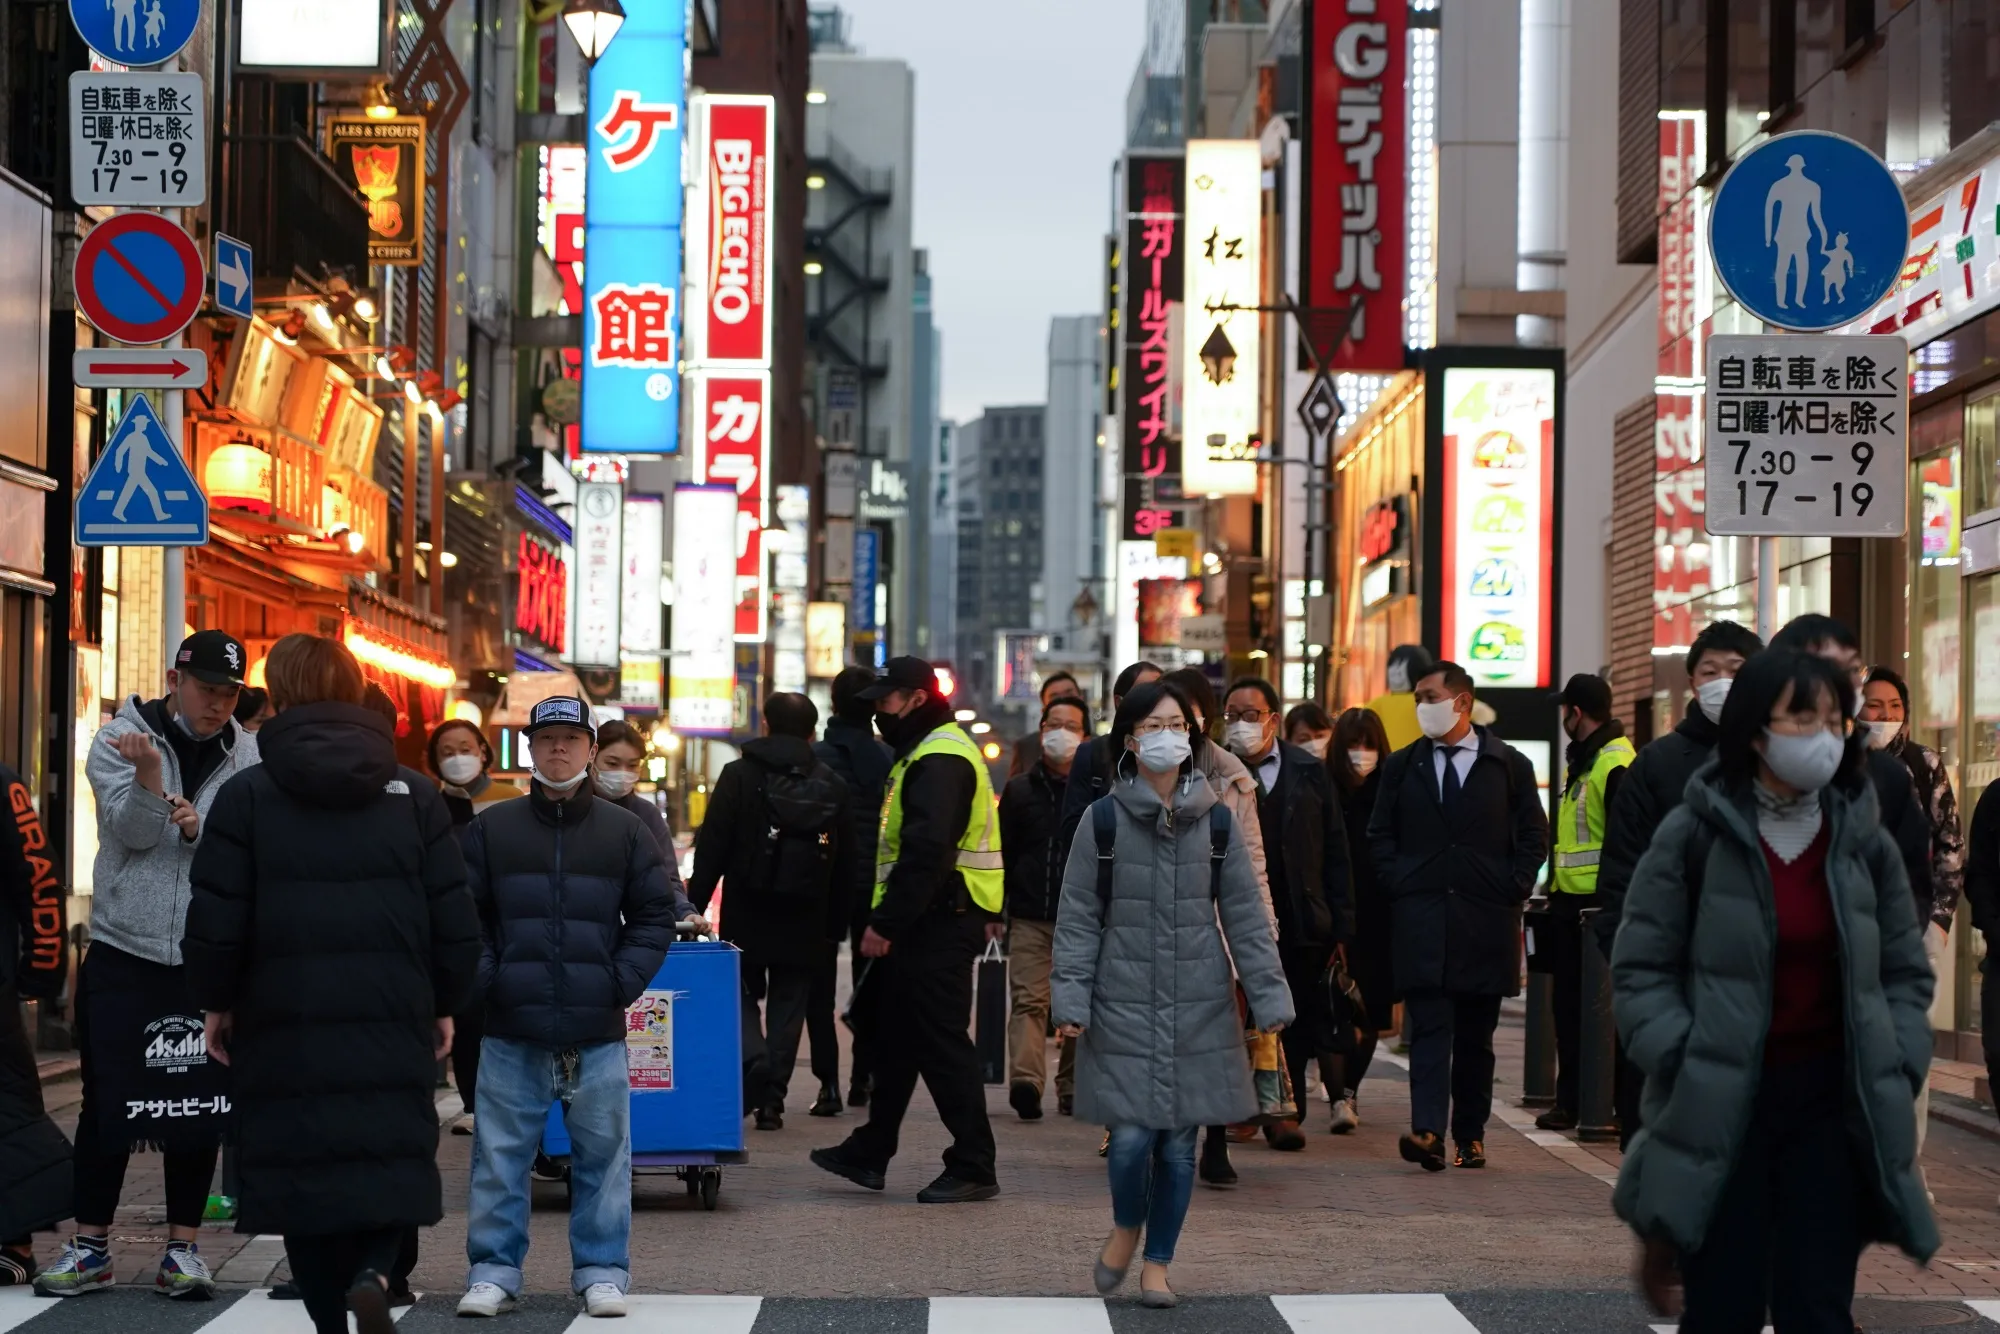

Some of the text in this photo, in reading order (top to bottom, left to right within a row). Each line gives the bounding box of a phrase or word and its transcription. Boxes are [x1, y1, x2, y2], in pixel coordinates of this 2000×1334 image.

[81, 86, 192, 112] 自転車を除く
[82, 116, 193, 140] 日曜・休日を除く
[334, 125, 361, 137] ALES
[374, 125, 419, 137] STOUTS
[91, 141, 132, 165] 7.30
[169, 142, 186, 166] 9
[92, 168, 120, 192] 17
[160, 169, 188, 194] 19
[1333, 0, 1389, 341] Gディッパー
[362, 200, 403, 238] UB
[713, 139, 752, 325] BIG ECHO
[376, 247, 412, 258] CHIPS
[1718, 355, 1898, 391] 自転車を除く
[1717, 400, 1896, 435] 日曜・休日を除く
[1728, 440, 1796, 475] 7.30
[1851, 441, 1875, 476] 9
[1737, 480, 1779, 515] 17
[1833, 481, 1875, 517] 19
[1134, 510, 1173, 535] 3F
[625, 1010, 646, 1032] 集
[145, 1031, 207, 1059] Asahi
[126, 1095, 232, 1119] アサヒビール
